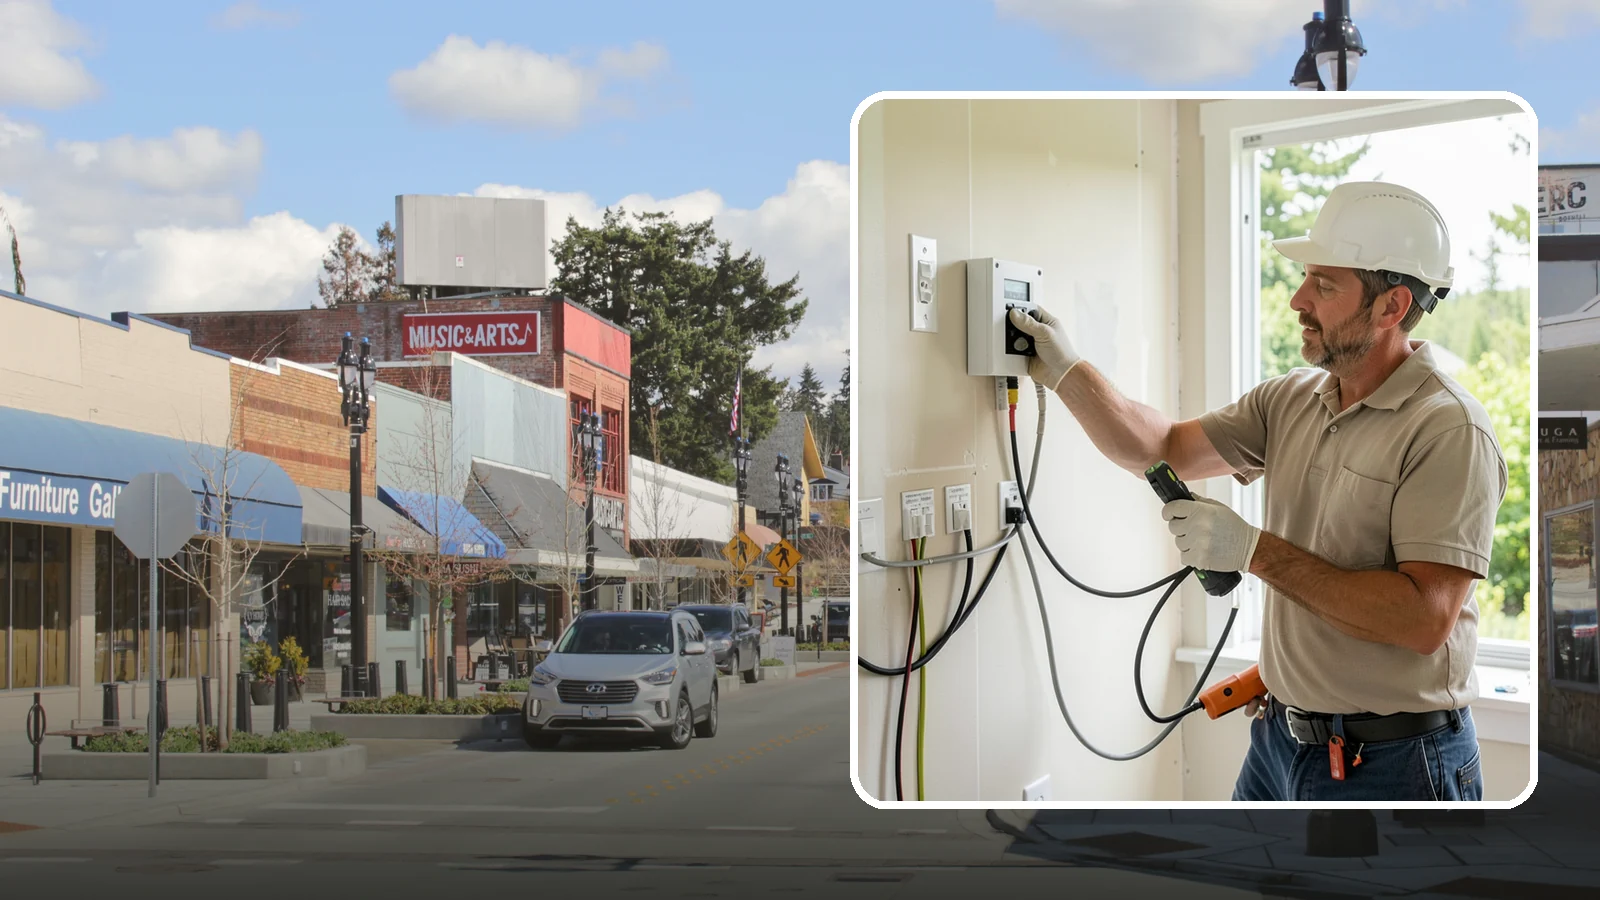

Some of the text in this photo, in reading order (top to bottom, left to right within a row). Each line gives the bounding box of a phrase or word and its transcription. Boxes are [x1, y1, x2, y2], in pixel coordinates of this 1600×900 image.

[408, 323, 519, 349] MUSIC&ARTS
[0, 471, 122, 519] Furniture Gal
[454, 563, 479, 574] SUSHI
